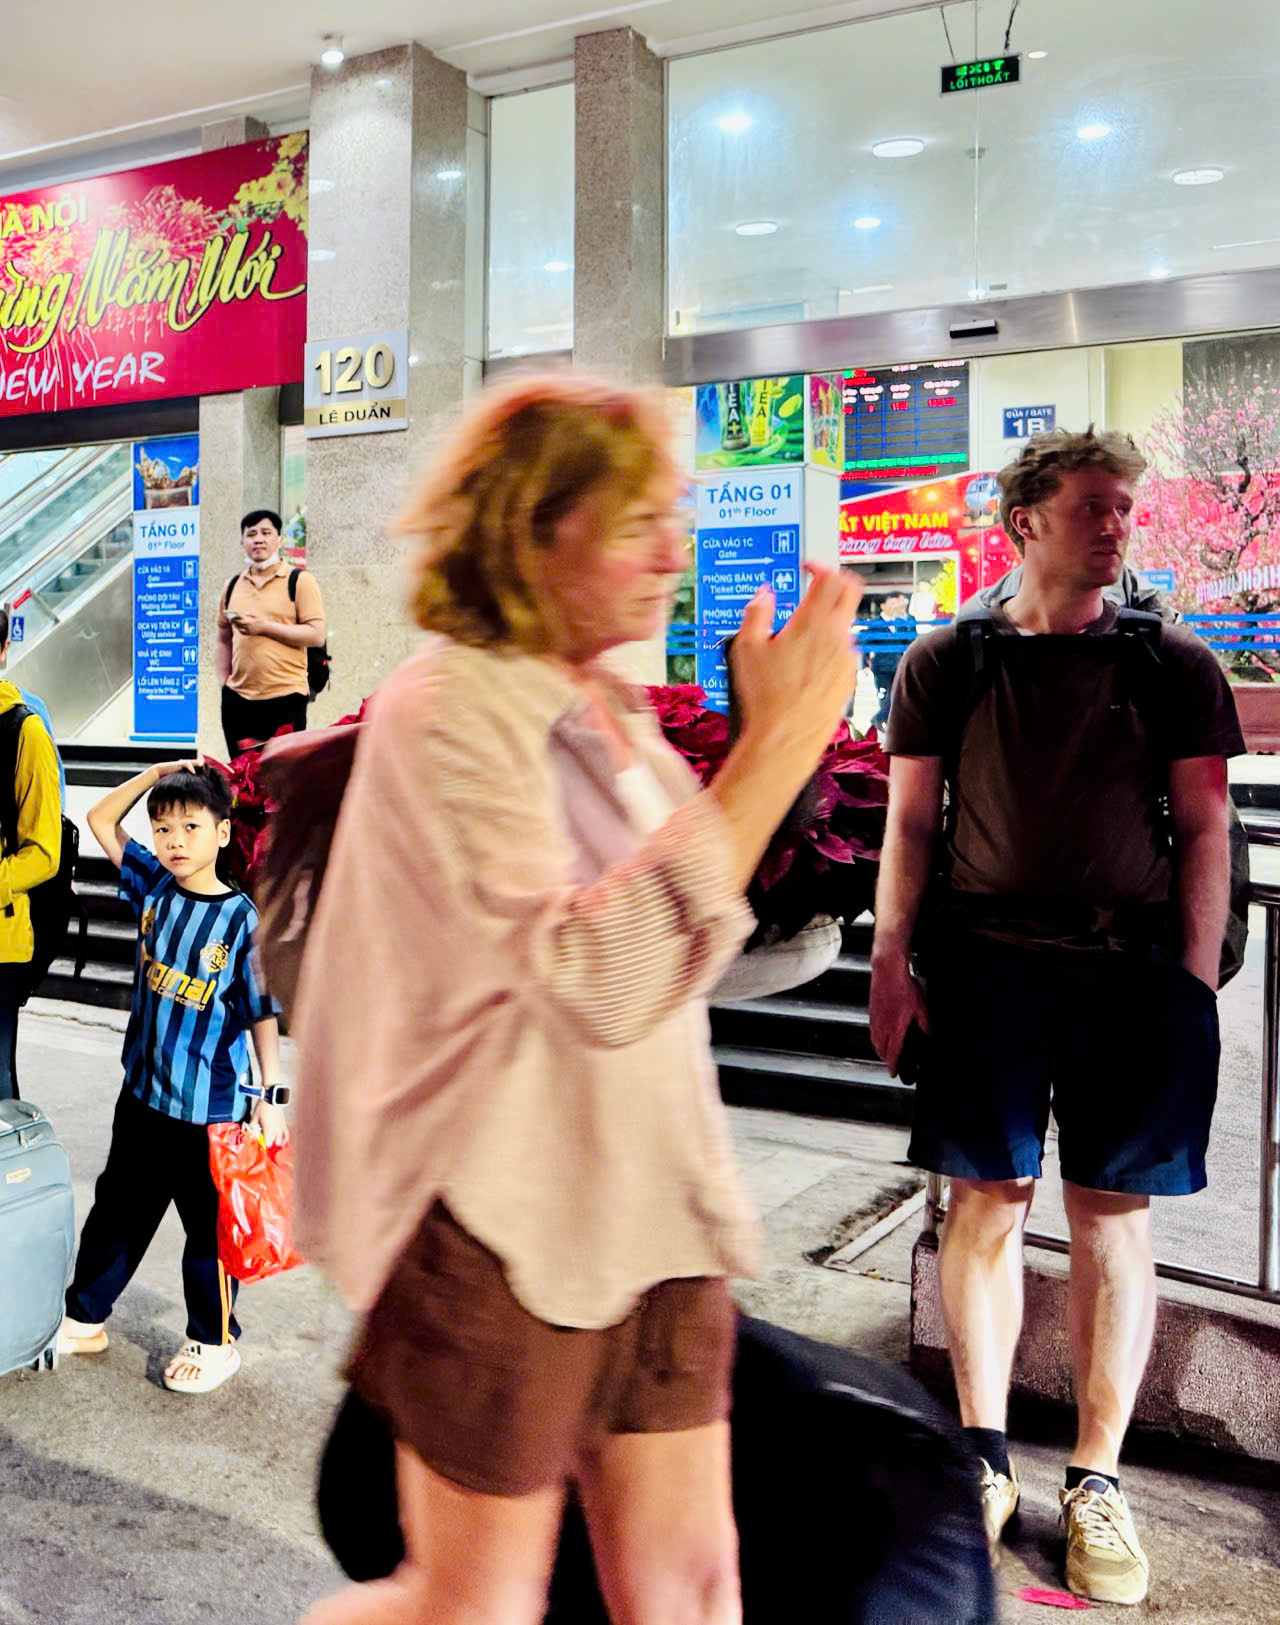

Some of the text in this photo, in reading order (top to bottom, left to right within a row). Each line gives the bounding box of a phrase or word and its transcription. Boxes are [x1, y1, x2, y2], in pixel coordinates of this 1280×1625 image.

[32, 192, 88, 233] NỘI
[66, 228, 210, 332] Năm
[186, 230, 307, 316] Mới
[71, 351, 166, 392] YEAR
[314, 343, 396, 395] 120
[319, 402, 392, 426] LÊ DUẨN
[706, 481, 792, 505] TẦNG 01
[744, 506, 777, 517] Floor
[862, 509, 900, 535] VIỆT
[902, 512, 949, 529] NAM
[181, 522, 195, 537] 01
[163, 540, 186, 550] Floor
[718, 550, 738, 559] Gate
[743, 537, 754, 548] 1C
[710, 584, 734, 595] Ticket
